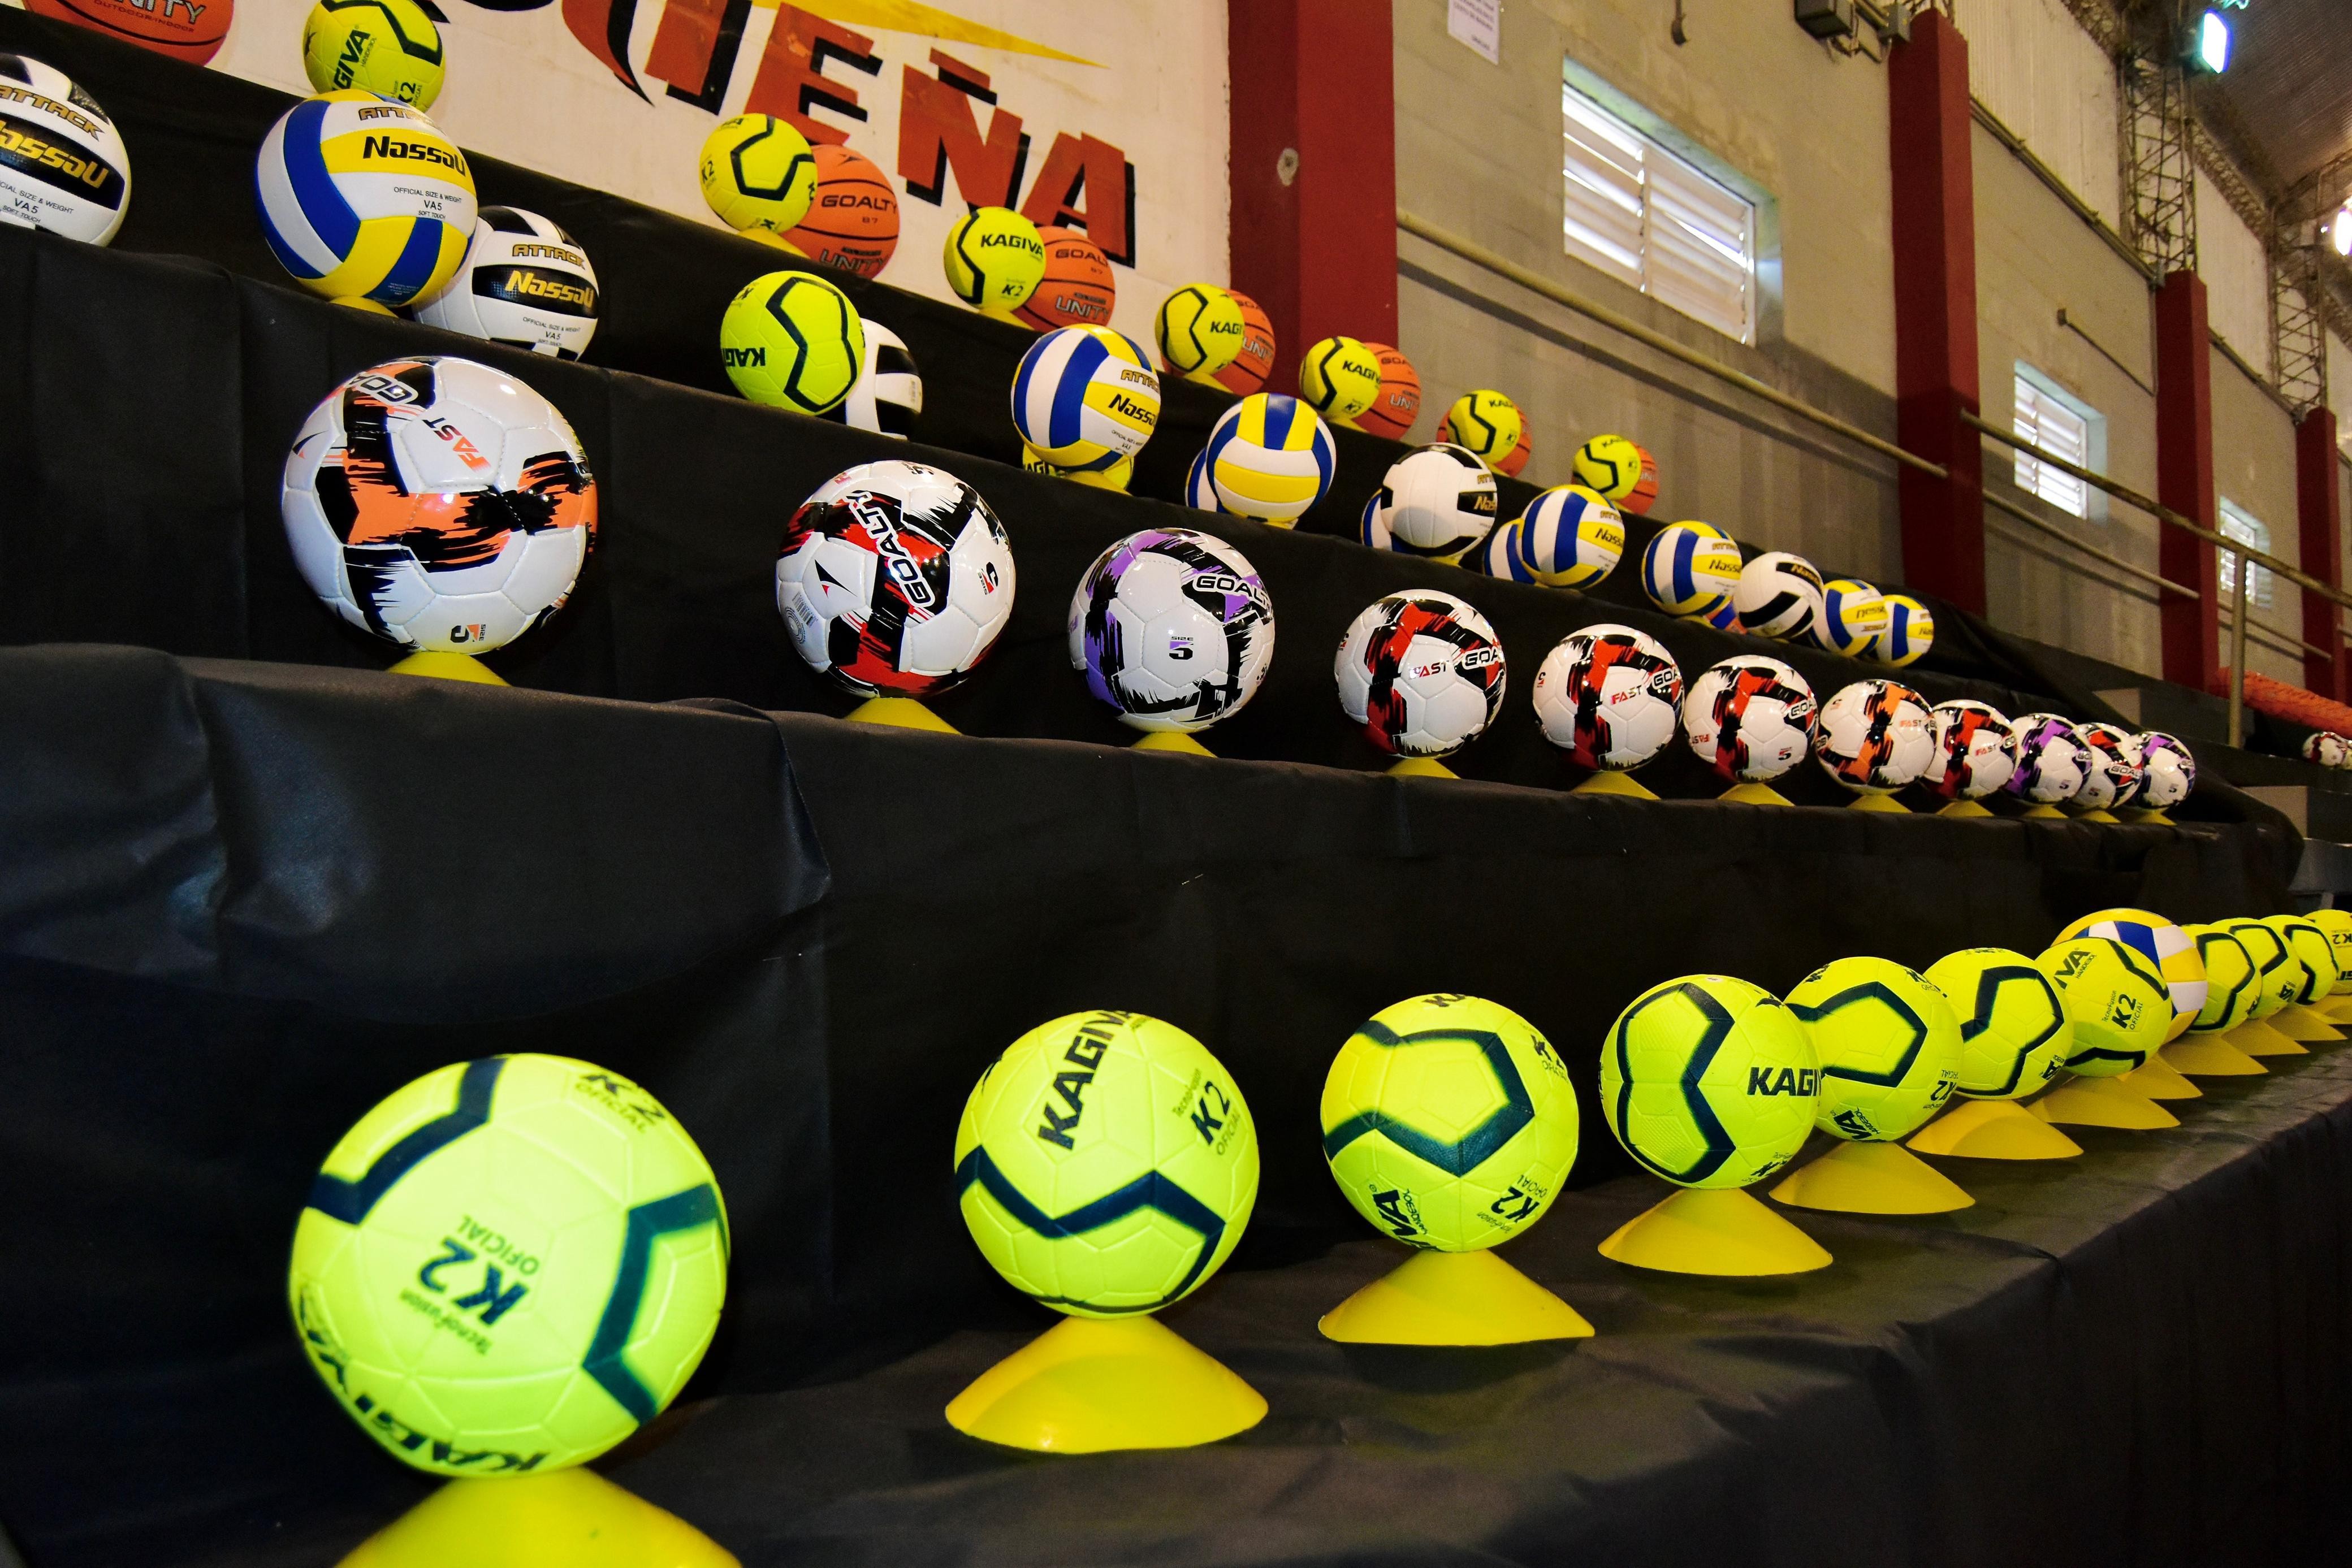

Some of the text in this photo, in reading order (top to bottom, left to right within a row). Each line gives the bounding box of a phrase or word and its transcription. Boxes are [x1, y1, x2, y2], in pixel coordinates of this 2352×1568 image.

[19, 189, 37, 202] SIZE
[46, 200, 75, 214] WEIGHT
[394, 186, 424, 196] OFFICIAL
[425, 190, 439, 199] SIZE
[444, 194, 462, 204] WEIGHT
[423, 200, 443, 211] VA5
[821, 194, 897, 214] GOALTY
[2, 205, 41, 224] SOFT TOUCH
[512, 244, 586, 270] ATTACK
[980, 233, 1044, 259] KAGIVA
[1001, 284, 1024, 297] K2
[522, 317, 547, 329] OFFICIAL
[421, 415, 491, 473] FAST
[846, 491, 934, 605] GOALTY
[1611, 685, 1642, 705] FAST
[2111, 994, 2137, 1029] K2
[2129, 1002, 2143, 1030] OFICIAL
[576, 1081, 656, 1133] OFICIAL
[1190, 1081, 1230, 1146] K2
[1216, 1110, 1242, 1156] OFICIAL
[1516, 1173, 1548, 1198] OFICIAL
[1491, 1185, 1541, 1224] K2
[455, 1213, 539, 1276] OFICIAL
[419, 1237, 530, 1326] K2
